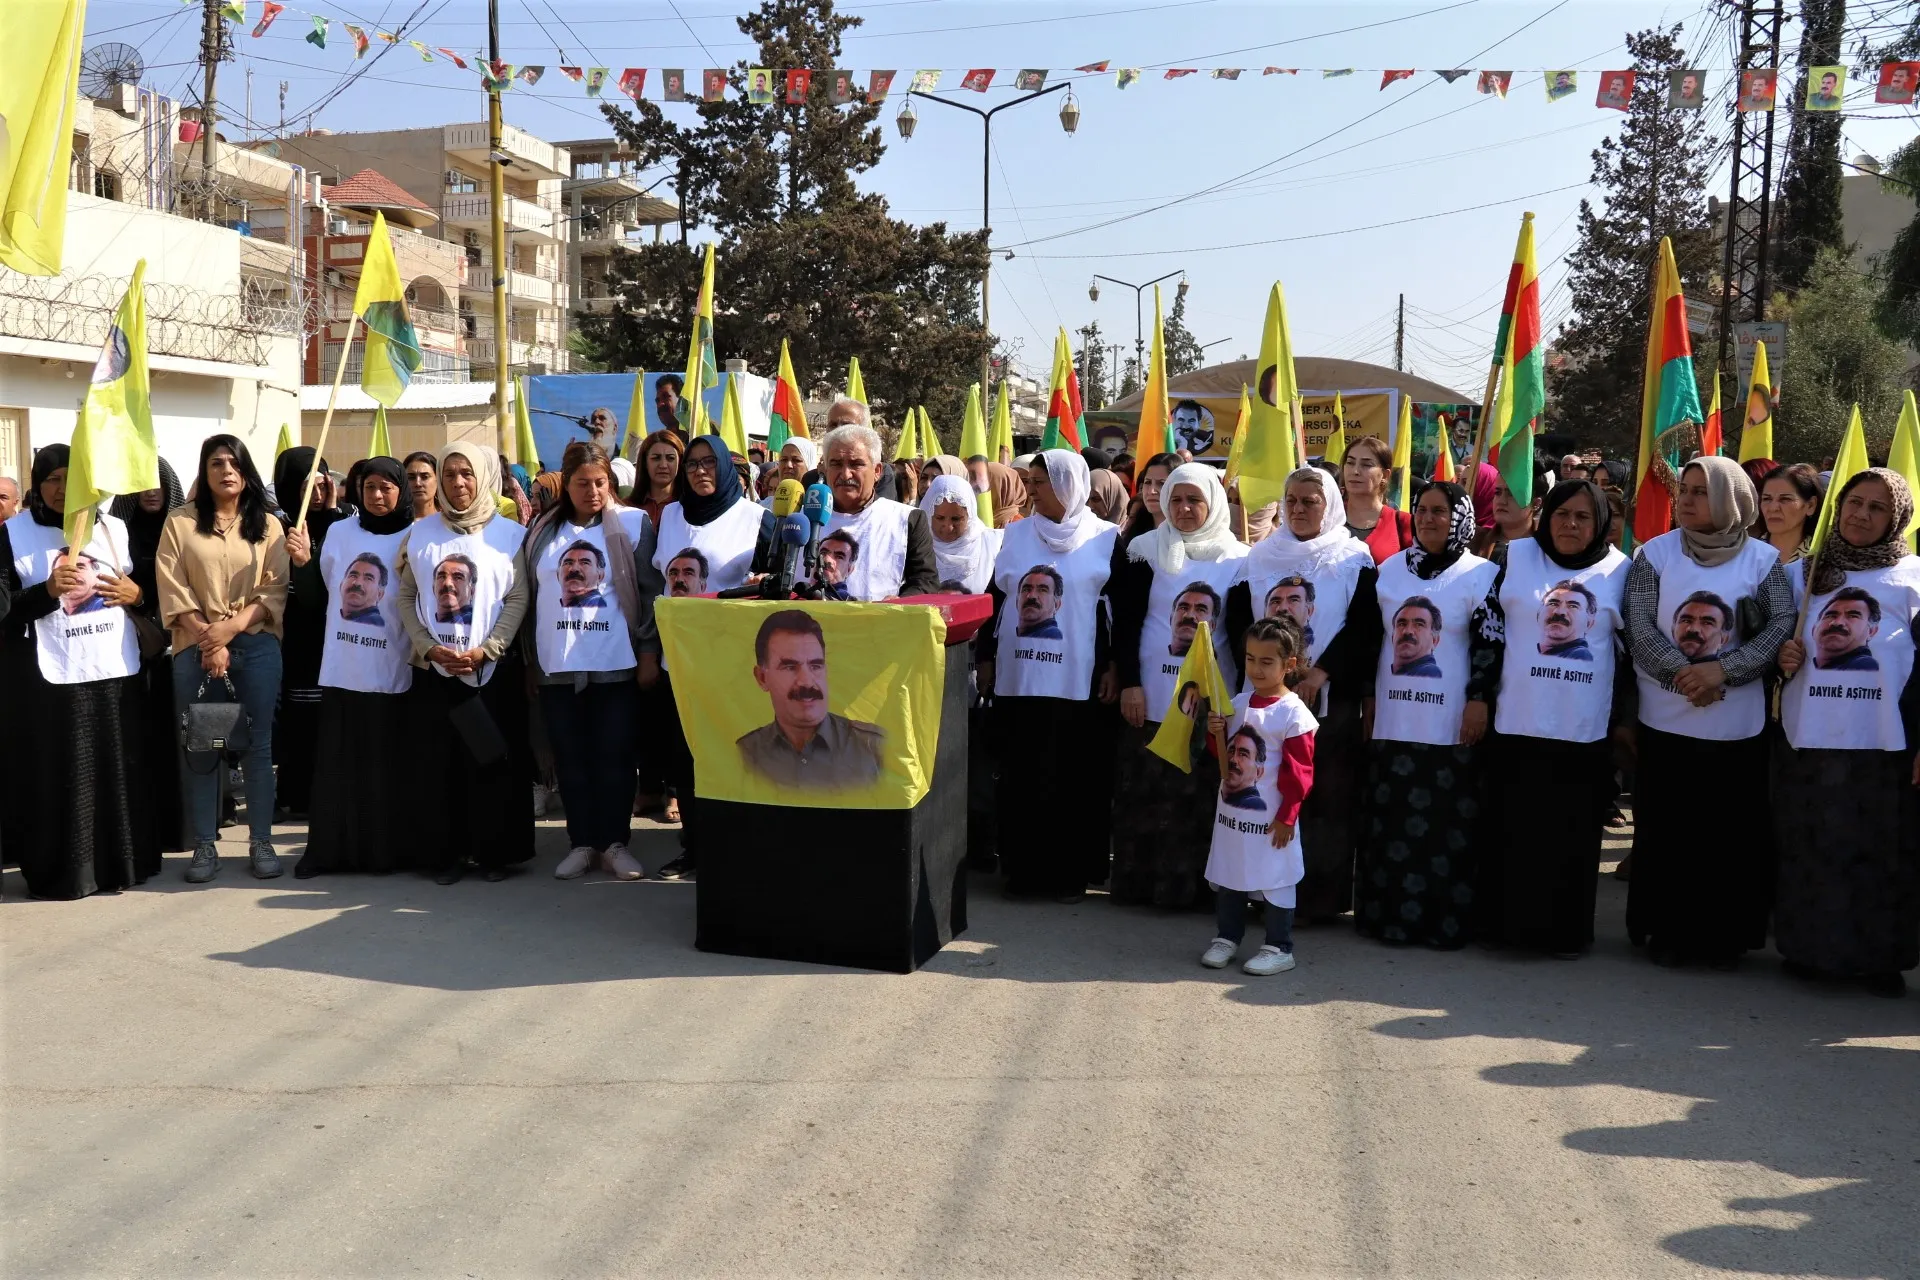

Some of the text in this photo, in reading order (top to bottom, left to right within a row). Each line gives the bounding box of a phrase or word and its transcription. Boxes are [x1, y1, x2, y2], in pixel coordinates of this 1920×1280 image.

[807, 489, 820, 504] R
[556, 619, 582, 631] DAYIKÊ
[1161, 663, 1180, 676] DAYI
[1530, 666, 1562, 680] DAYIKÊ
[1388, 688, 1413, 701] DAYIKÊ
[1809, 684, 1843, 699] DAYIKÊ
